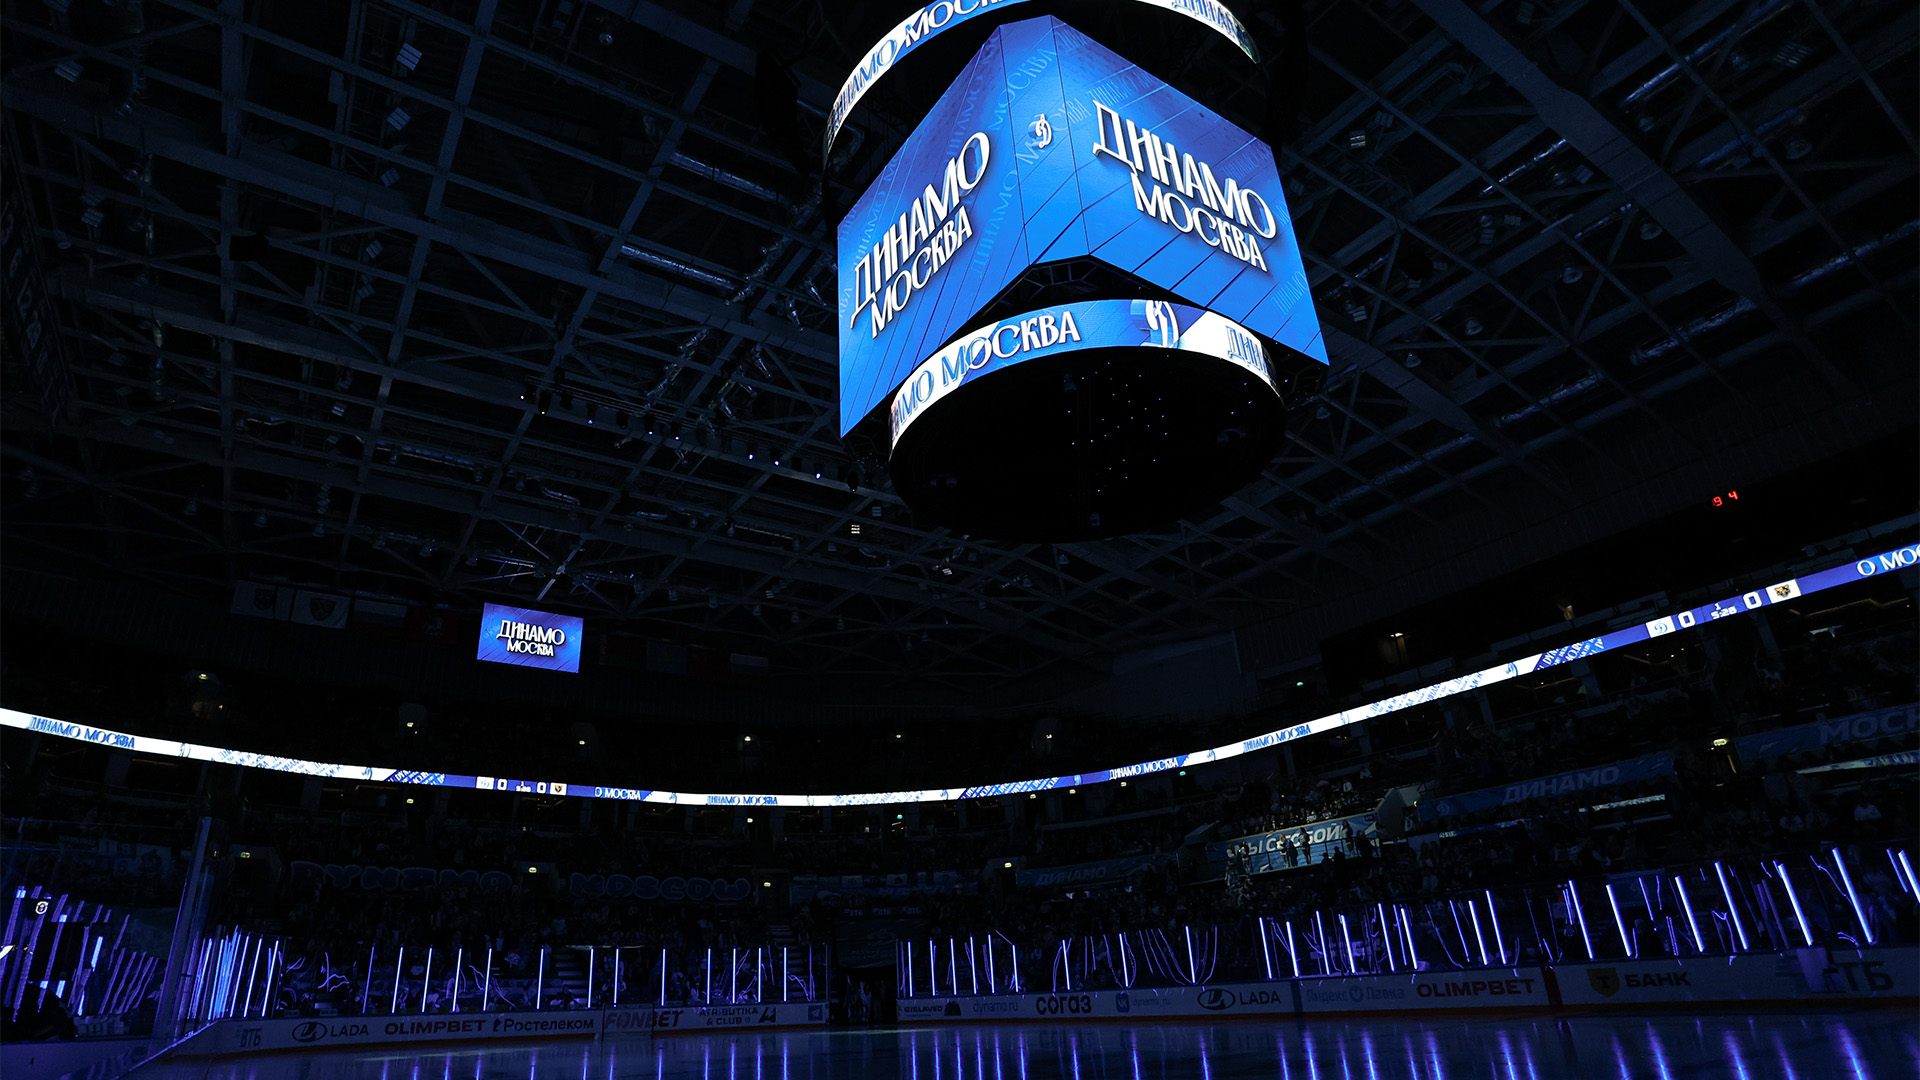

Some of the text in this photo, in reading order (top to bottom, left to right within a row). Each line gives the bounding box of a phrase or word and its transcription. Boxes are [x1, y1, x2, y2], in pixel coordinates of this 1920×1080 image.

[1093, 100, 1277, 239] ДИНАМО
[850, 132, 991, 329] ДИНАМО
[1130, 171, 1268, 272] МОСКВА
[870, 205, 974, 340] МОСКВА
[941, 311, 1080, 387] МОСКВА
[496, 619, 566, 646] ДИНАМО
[507, 640, 554, 657] МОСКВА
[28, 716, 135, 749] ДИНАМО МОСКВА
[1109, 757, 1179, 780] ДИНАМО МОСКВА
[1502, 766, 1620, 806] ДИНАМО
[1416, 979, 1535, 998] OLIMPBET
[1625, 971, 1691, 988] БАНК
[1239, 991, 1281, 1005] LADA
[330, 1024, 369, 1037] LADA
[384, 1020, 486, 1036] OLIMPBET
[503, 1018, 594, 1032] Ростелеком
